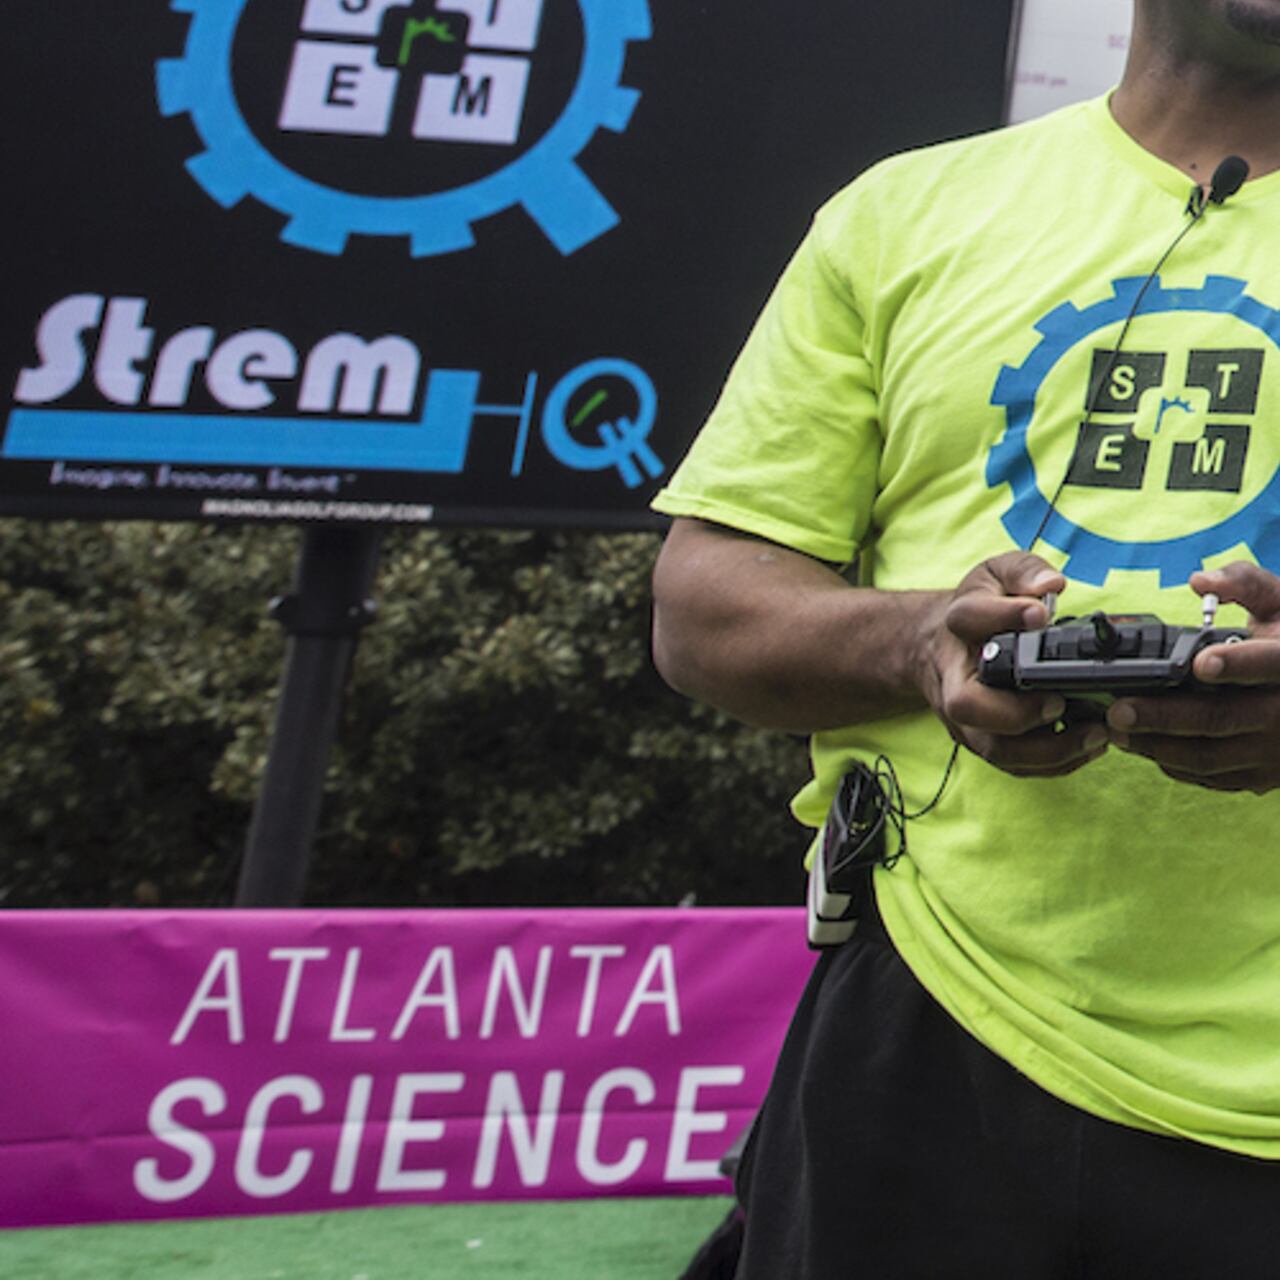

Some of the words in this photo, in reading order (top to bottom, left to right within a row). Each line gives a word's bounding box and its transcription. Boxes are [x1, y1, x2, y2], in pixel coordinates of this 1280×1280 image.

[14, 295, 419, 415] Strem
[170, 944, 681, 1045] ATLANTA
[133, 1065, 746, 1201] SCIENCE
